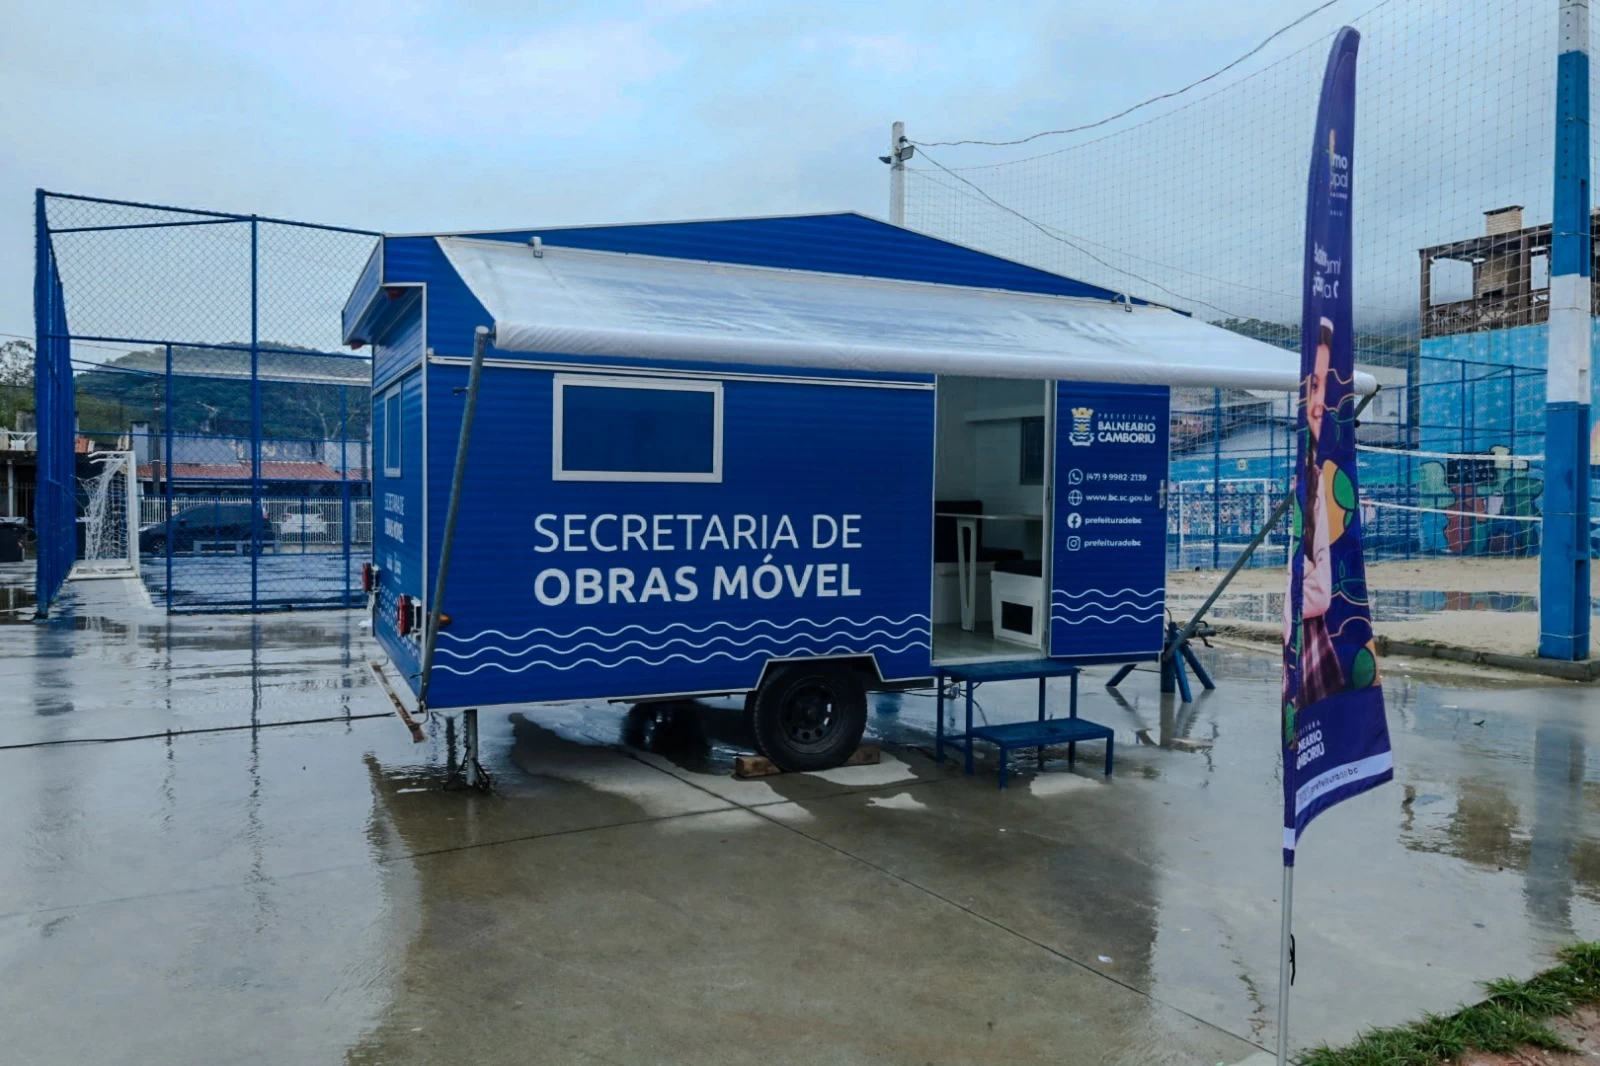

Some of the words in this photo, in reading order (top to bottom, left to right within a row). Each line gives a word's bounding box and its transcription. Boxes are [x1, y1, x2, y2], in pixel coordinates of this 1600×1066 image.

[1097, 413, 1157, 421] PREFEITURA
[1086, 472, 1101, 481] (47)
[1108, 473, 1147, 482] 9982-2139
[1085, 493, 1153, 503] www.bc.sc.gov.br
[1084, 516, 1142, 526] prefeituradebc
[533, 513, 800, 553] SECRETARIA
[812, 514, 862, 549] DE
[1083, 539, 1142, 548] prefeituradebc
[533, 565, 699, 606] OBRAS
[712, 553, 862, 600] MÓVEL
